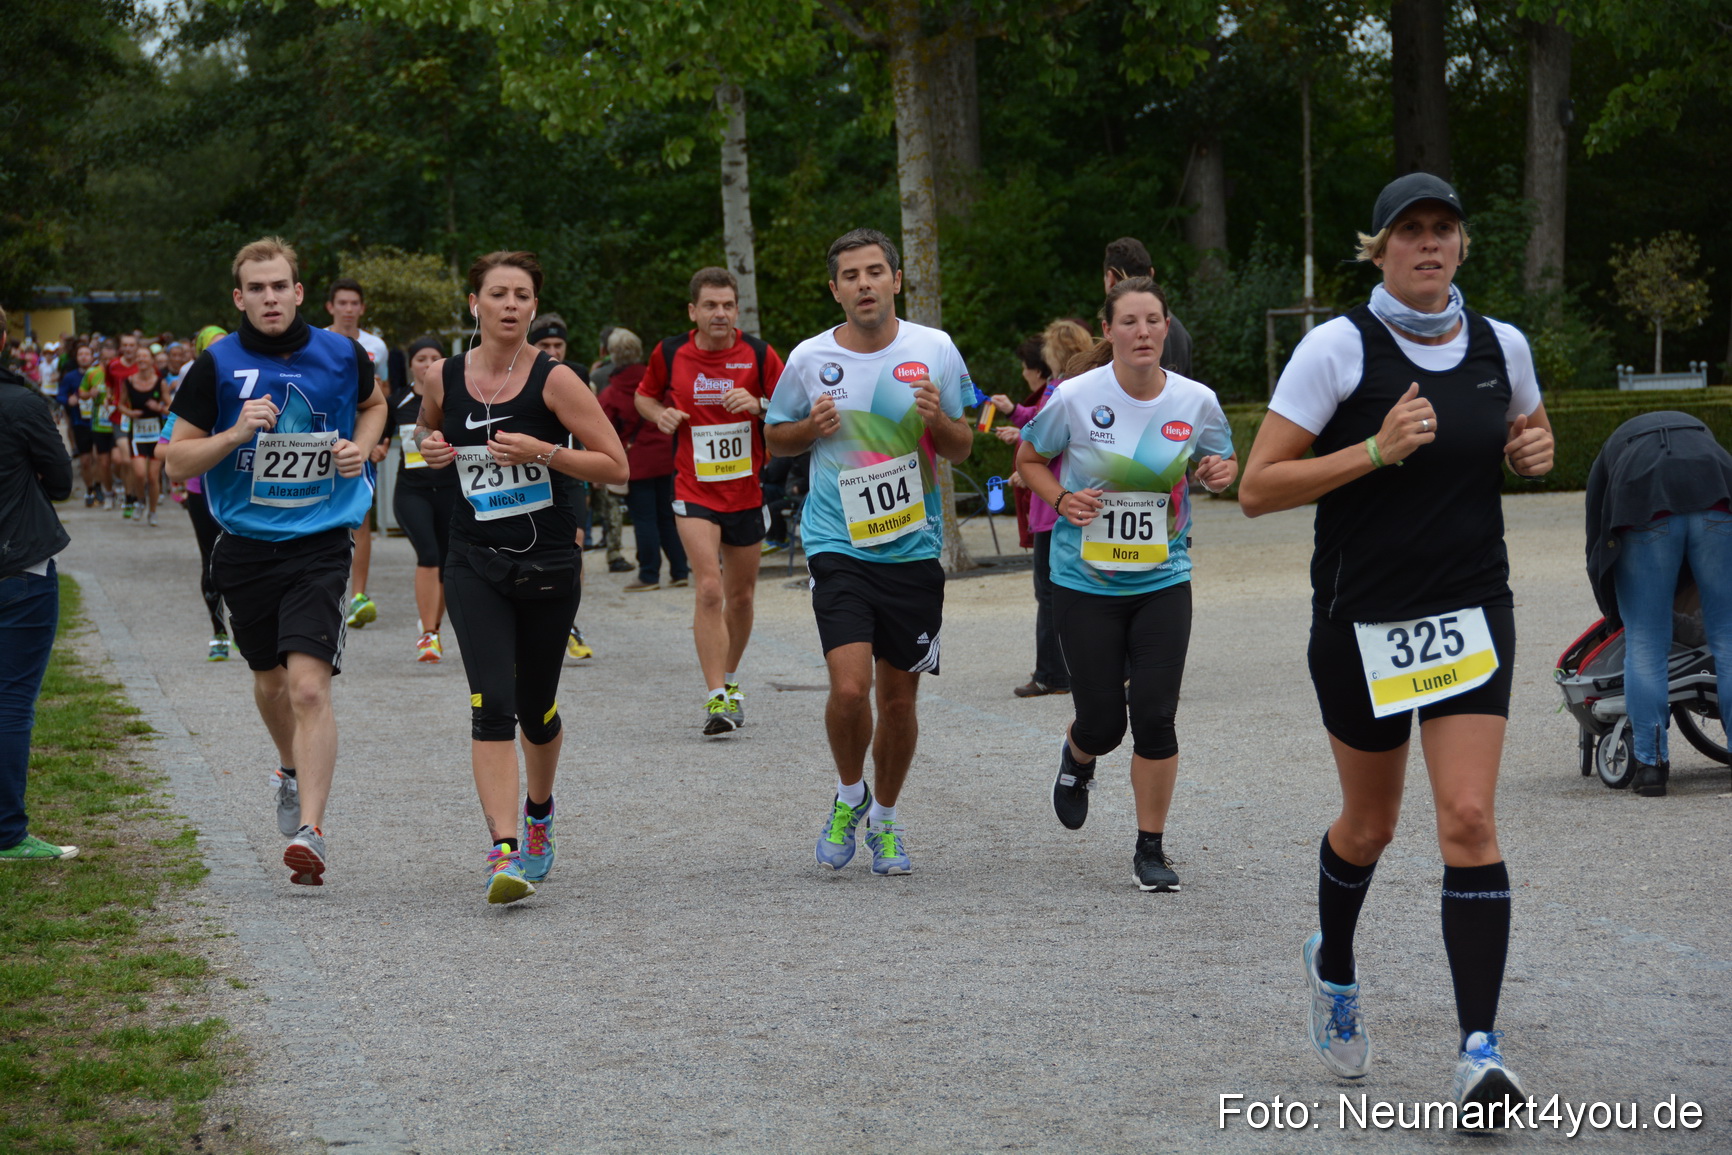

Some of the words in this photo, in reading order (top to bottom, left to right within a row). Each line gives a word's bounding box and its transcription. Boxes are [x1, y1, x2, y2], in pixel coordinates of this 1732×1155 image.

[897, 366, 925, 377] Hervis
[234, 369, 259, 399] 7
[1090, 430, 1115, 440] PARTL
[1165, 425, 1190, 437] Hervis
[259, 440, 288, 448] PARTL
[289, 440, 328, 448] Neumarkt
[706, 437, 742, 460] 180
[263, 450, 332, 479] 2279
[457, 453, 484, 462] PARTL
[467, 461, 542, 491] 2316
[715, 463, 736, 473] Peter
[840, 474, 868, 488] PARTL
[868, 464, 907, 481] Neumarkt
[268, 485, 320, 497] Alexander
[489, 491, 526, 508] Nicola
[858, 476, 911, 515] 104
[1116, 499, 1154, 508] Neumarkt
[867, 512, 911, 535] Matthias
[1102, 510, 1153, 541] 105
[1112, 547, 1139, 560] Nora
[1387, 616, 1465, 669] 325
[1412, 668, 1458, 693] Lunel
